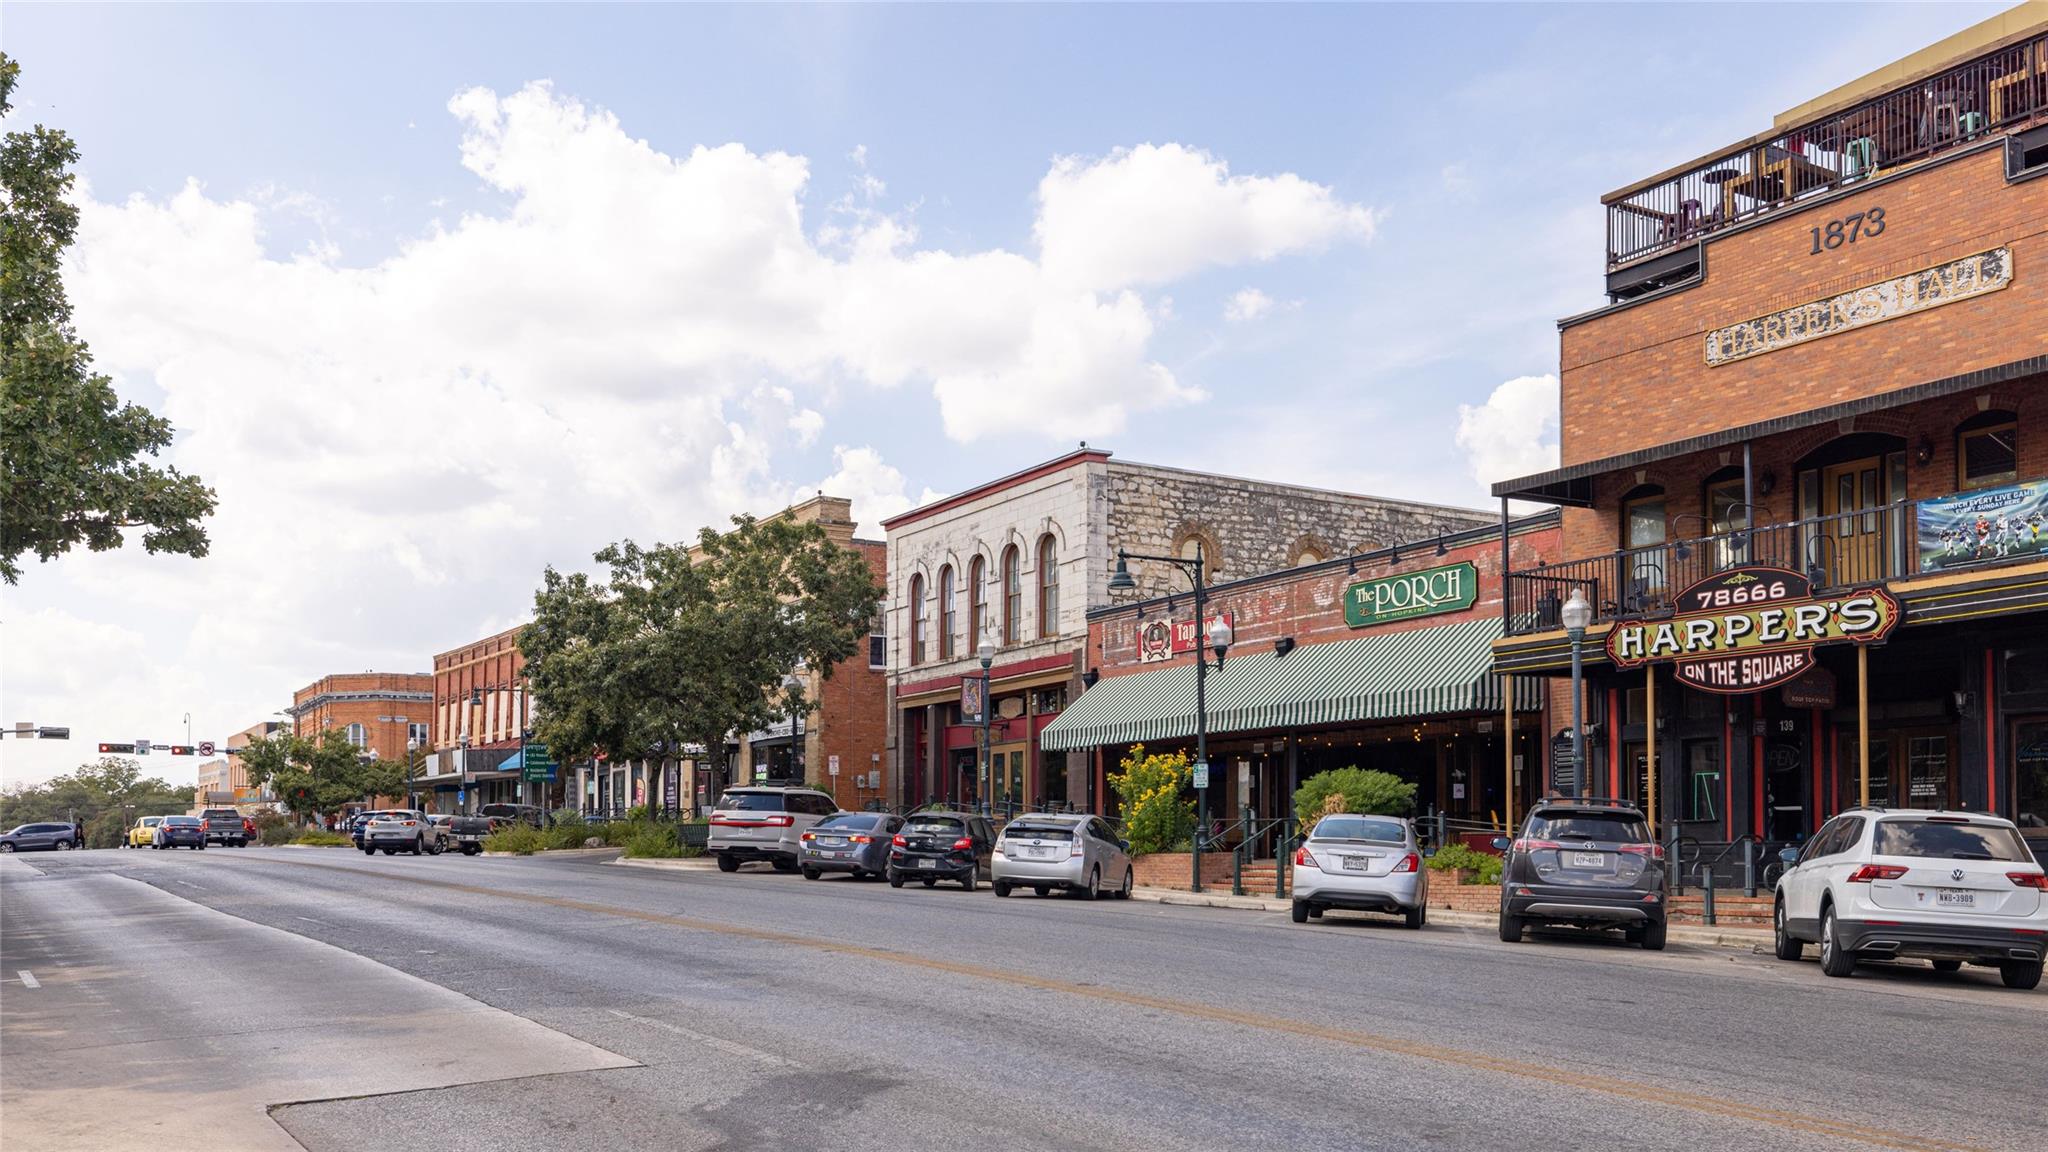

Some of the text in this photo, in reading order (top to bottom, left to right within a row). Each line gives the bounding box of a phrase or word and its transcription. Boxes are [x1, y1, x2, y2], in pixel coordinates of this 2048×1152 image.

[1810, 206, 1886, 256] 1873
[1717, 257, 1999, 359] HARPER'S HALL
[1943, 488, 2035, 511] WATCH EVERY LIVE GAME
[1954, 506, 1976, 514] EVERY
[1977, 501, 2004, 511] SUNDAY
[1355, 587, 1375, 604] The
[1375, 568, 1463, 615] PORCH
[1697, 581, 1786, 608] 78666
[1391, 606, 1428, 617] HOPKINS
[1620, 597, 1879, 658] HARPER'S
[1684, 653, 1804, 686] ON THE SQUARE
[1780, 720, 1794, 731] 139
